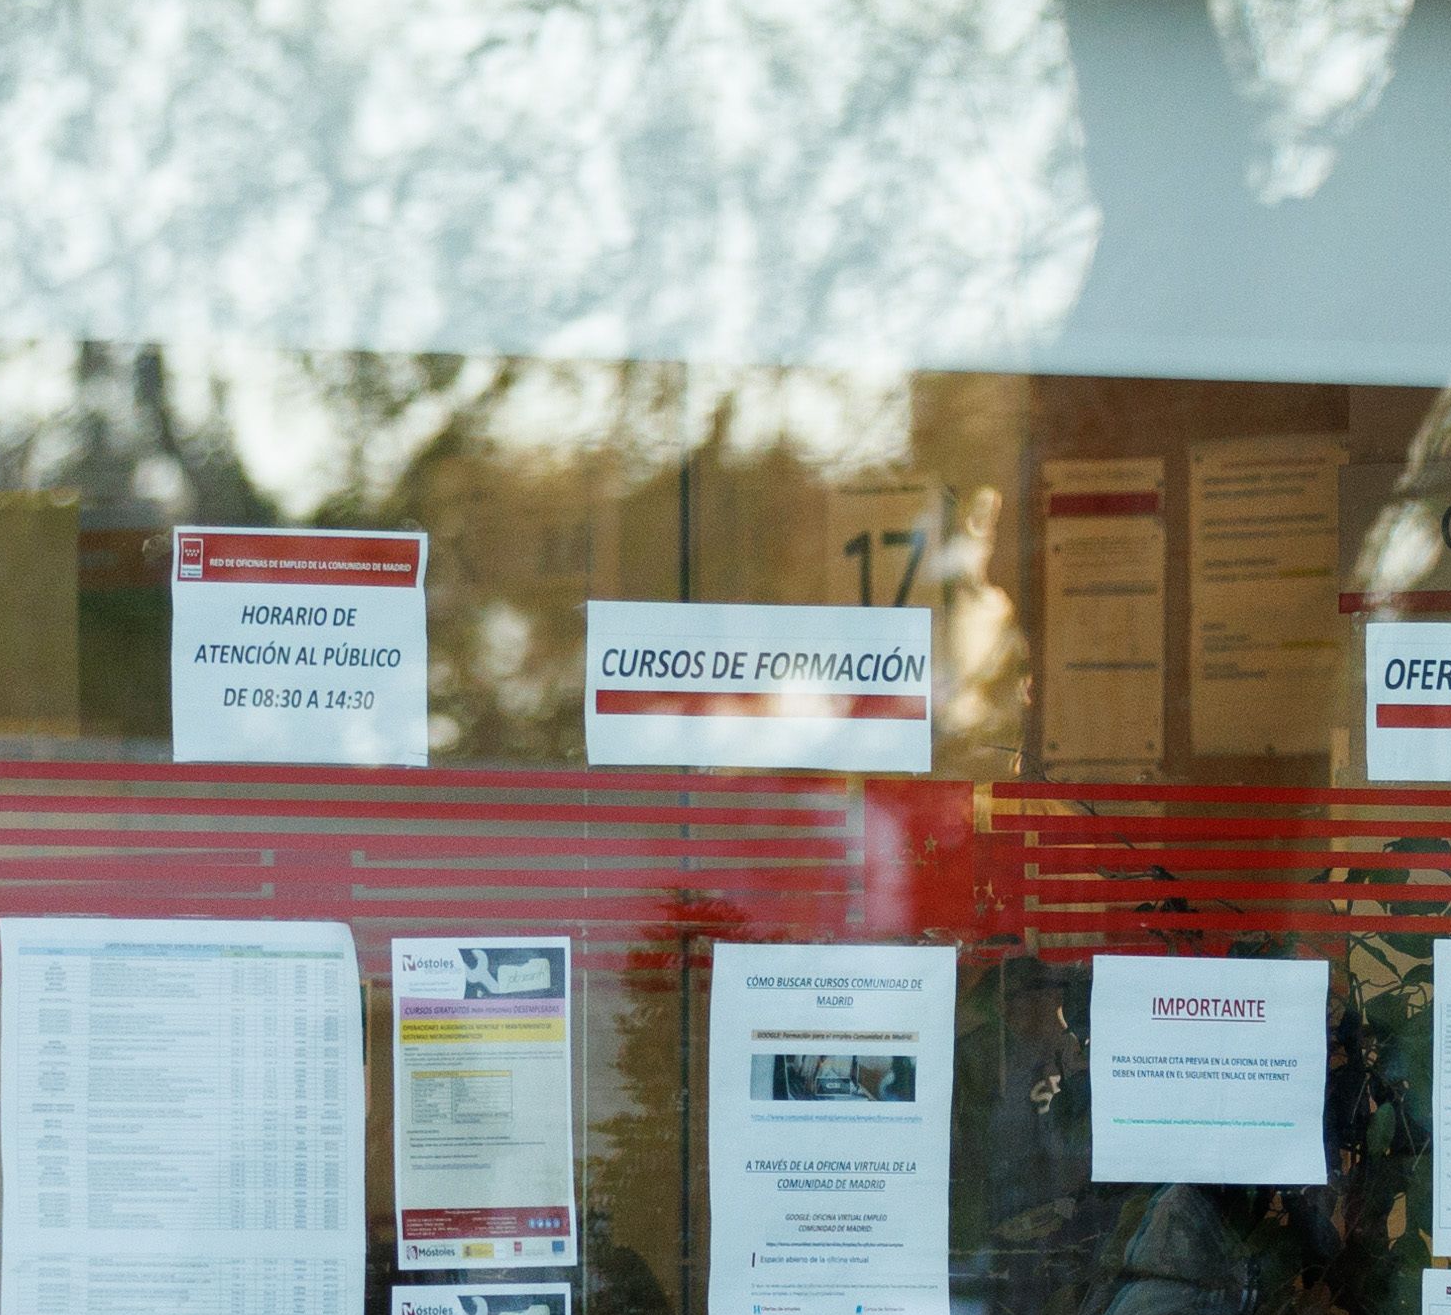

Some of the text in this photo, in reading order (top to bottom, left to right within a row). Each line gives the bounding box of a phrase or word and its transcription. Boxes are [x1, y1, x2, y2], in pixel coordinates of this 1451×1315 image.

[241, 606, 357, 626] HORARIO DE
[194, 641, 401, 667] ATENCIÓN AL PÚBLICO
[601, 647, 925, 683] CURSOS DE FORMACIÓN
[223, 688, 375, 709] DE 08:30 A 14:30
[746, 976, 923, 989] CÓMO BUSCAR CURSOS COMUNIDAD DE
[816, 995, 854, 1006] MADRID
[1152, 997, 1266, 1018] IMPORTANTE
[1112, 1055, 1130, 1063] PARA
[1133, 1056, 1167, 1064] SOLICITAR
[1185, 1057, 1209, 1065] PREVIA
[1211, 1057, 1220, 1065] EN
[1221, 1057, 1229, 1065] LA
[1231, 1058, 1258, 1066] OFICINA
[1270, 1059, 1297, 1067] EMPLEO
[1112, 1070, 1135, 1078] DEBEN
[1137, 1070, 1164, 1078] ENTRAR
[1177, 1071, 1184, 1079] EL
[1186, 1071, 1219, 1079] SIGUIENTE
[1221, 1072, 1246, 1080] ENLACE
[1247, 1072, 1256, 1080] DE
[1258, 1072, 1289, 1080] INTERNET
[746, 1159, 916, 1172] A TRAVÉS DE LA OFICINA VIRTUAL DE LA
[777, 1179, 886, 1190] COMUNIDAD DE MADRID
